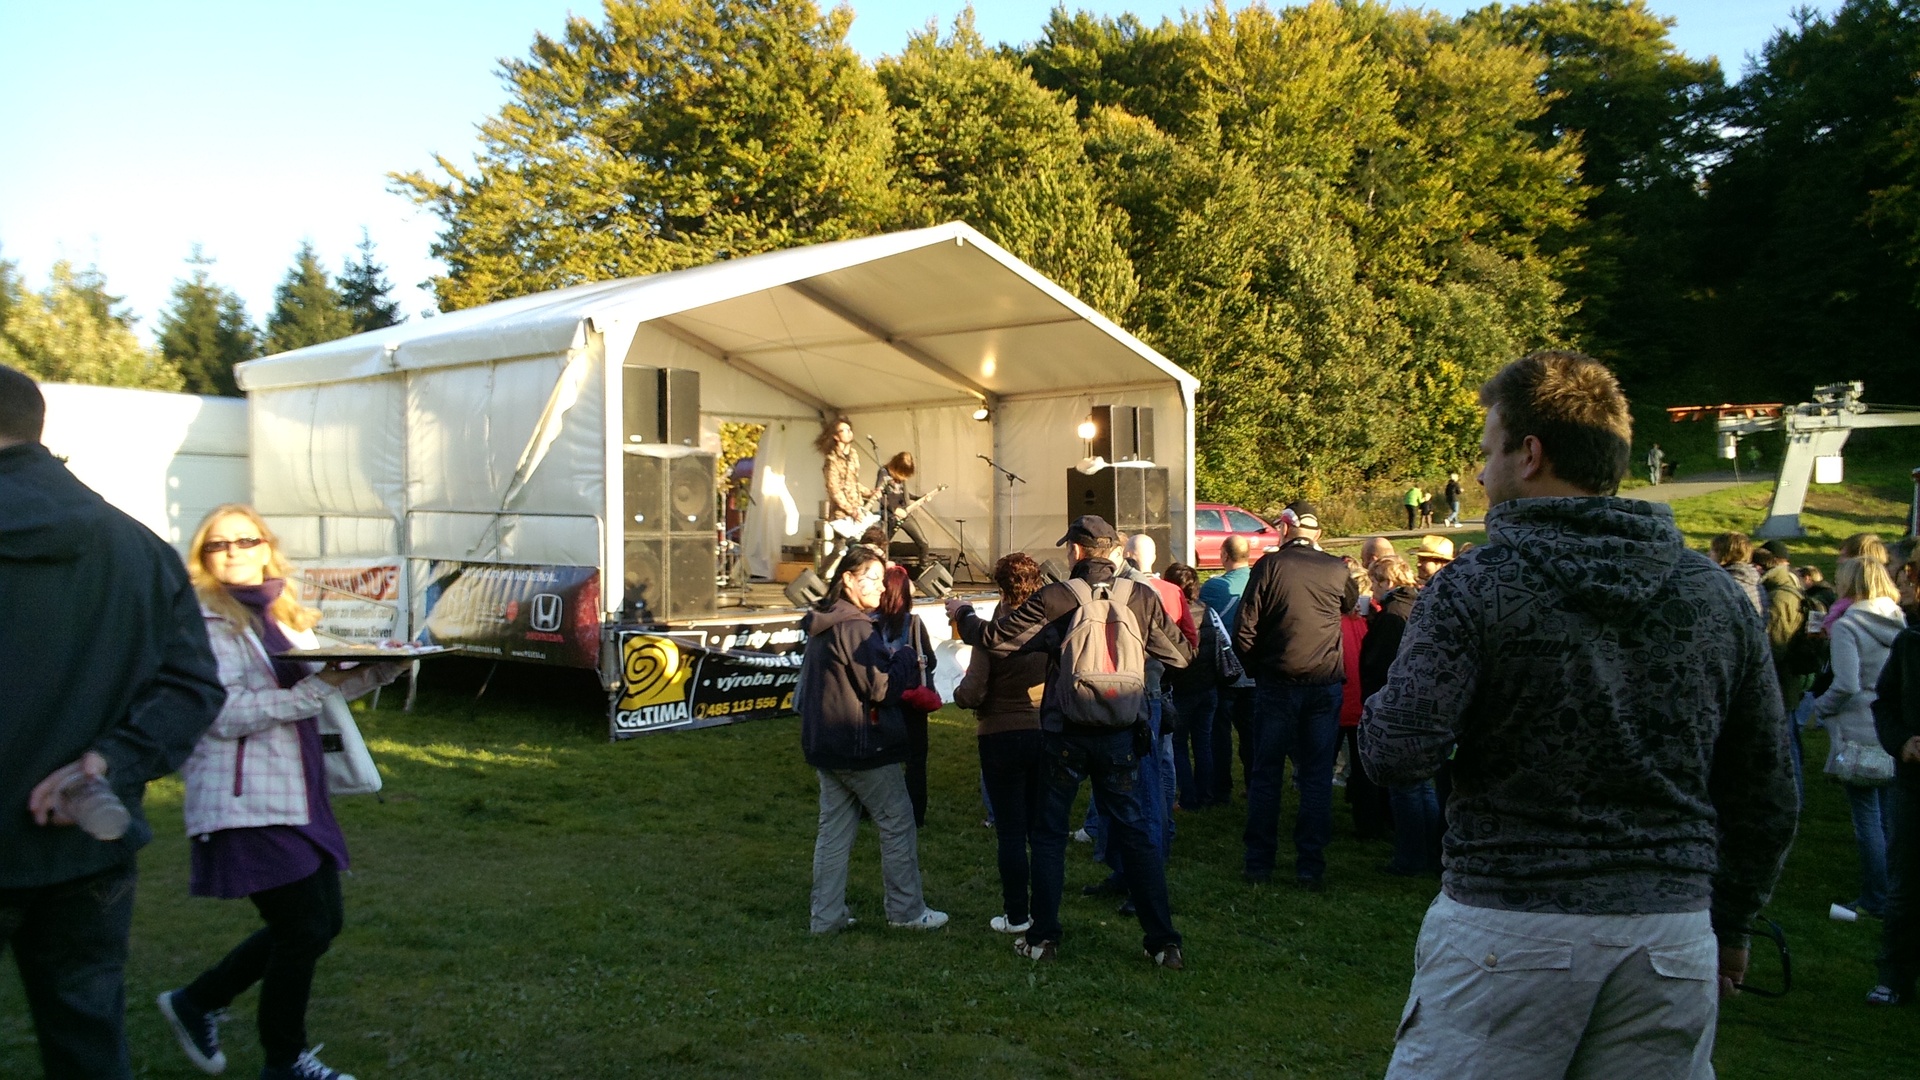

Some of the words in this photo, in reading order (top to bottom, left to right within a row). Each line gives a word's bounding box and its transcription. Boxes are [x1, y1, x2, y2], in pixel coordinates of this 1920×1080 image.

[305, 571, 397, 596] BAUHAUS
[722, 629, 771, 653] párty
[717, 672, 775, 692] výroba
[616, 701, 688, 728] CELTIMA
[706, 702, 731, 716] 485
[731, 699, 754, 713] 113
[755, 696, 778, 710] 556
